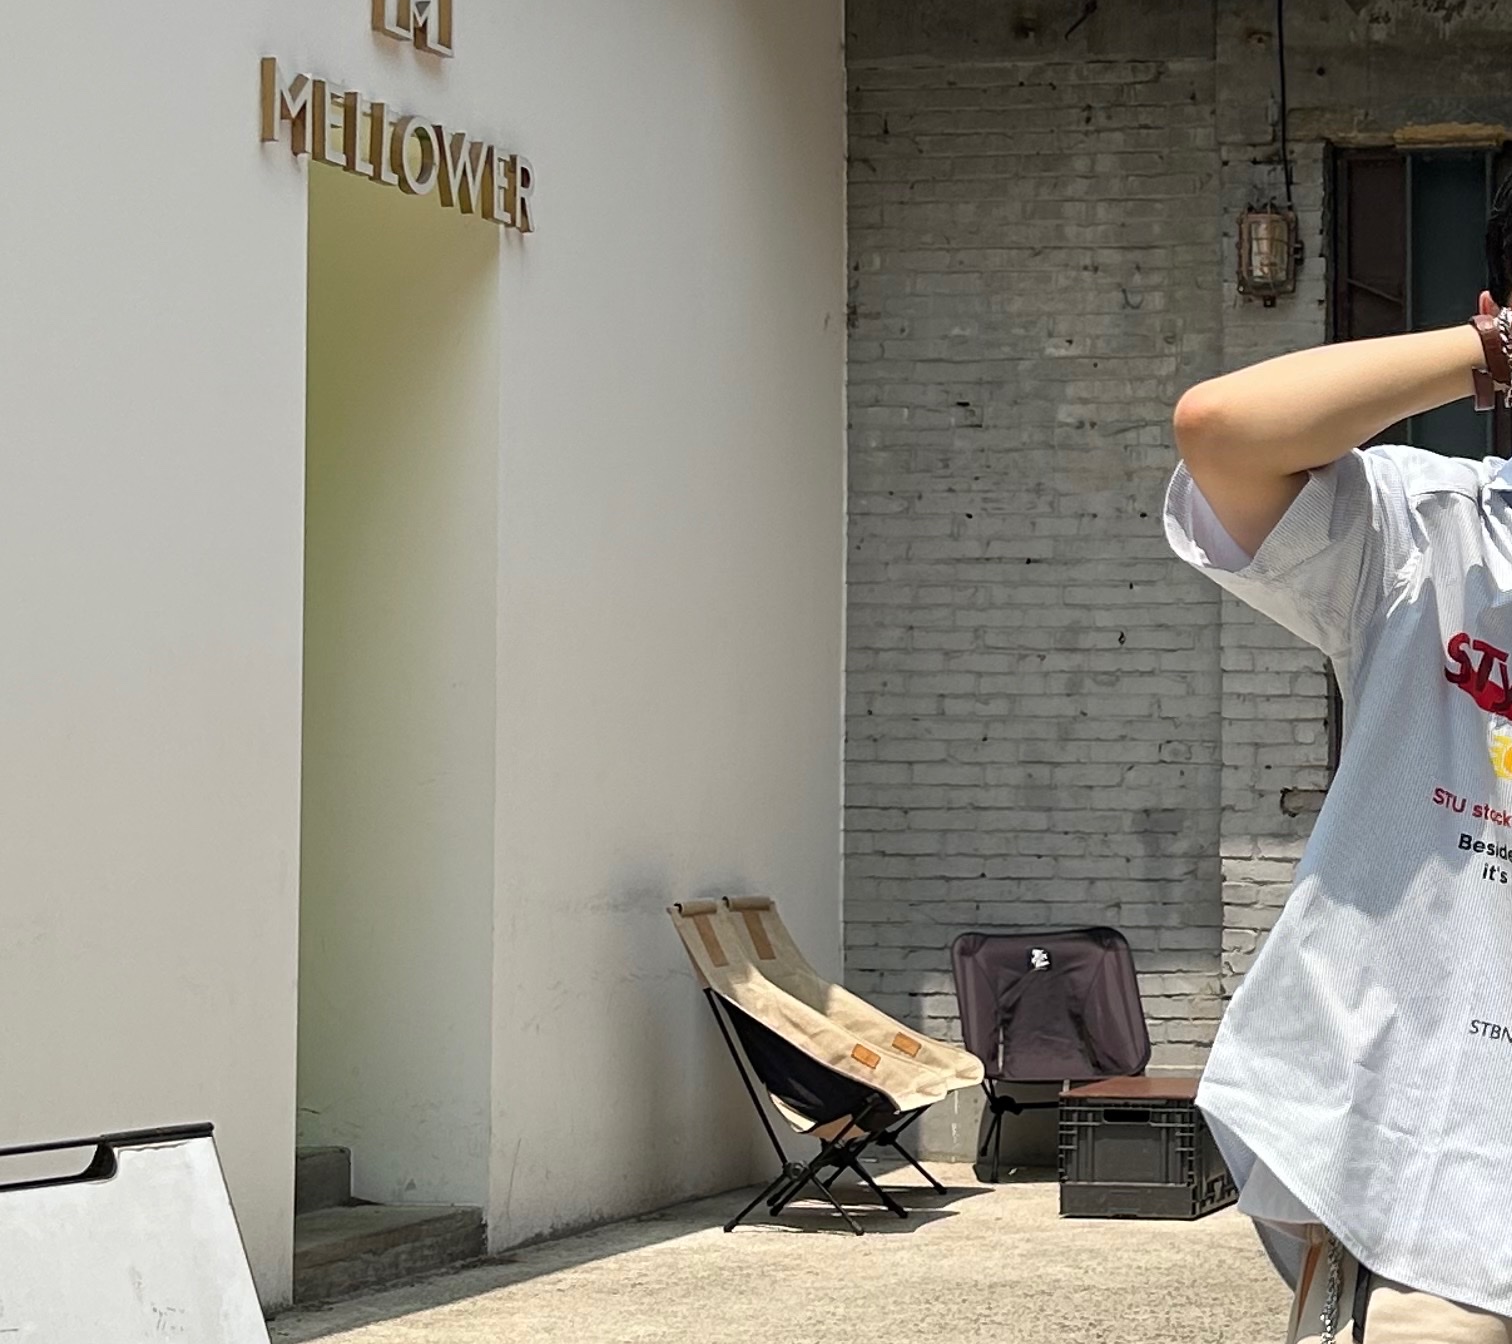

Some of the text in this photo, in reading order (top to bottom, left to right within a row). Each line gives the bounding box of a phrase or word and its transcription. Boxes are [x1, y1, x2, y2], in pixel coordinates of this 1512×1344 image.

[260, 55, 535, 233] MELLOWER
[1433, 787, 1467, 813] STU
[1482, 863, 1508, 885] it's
